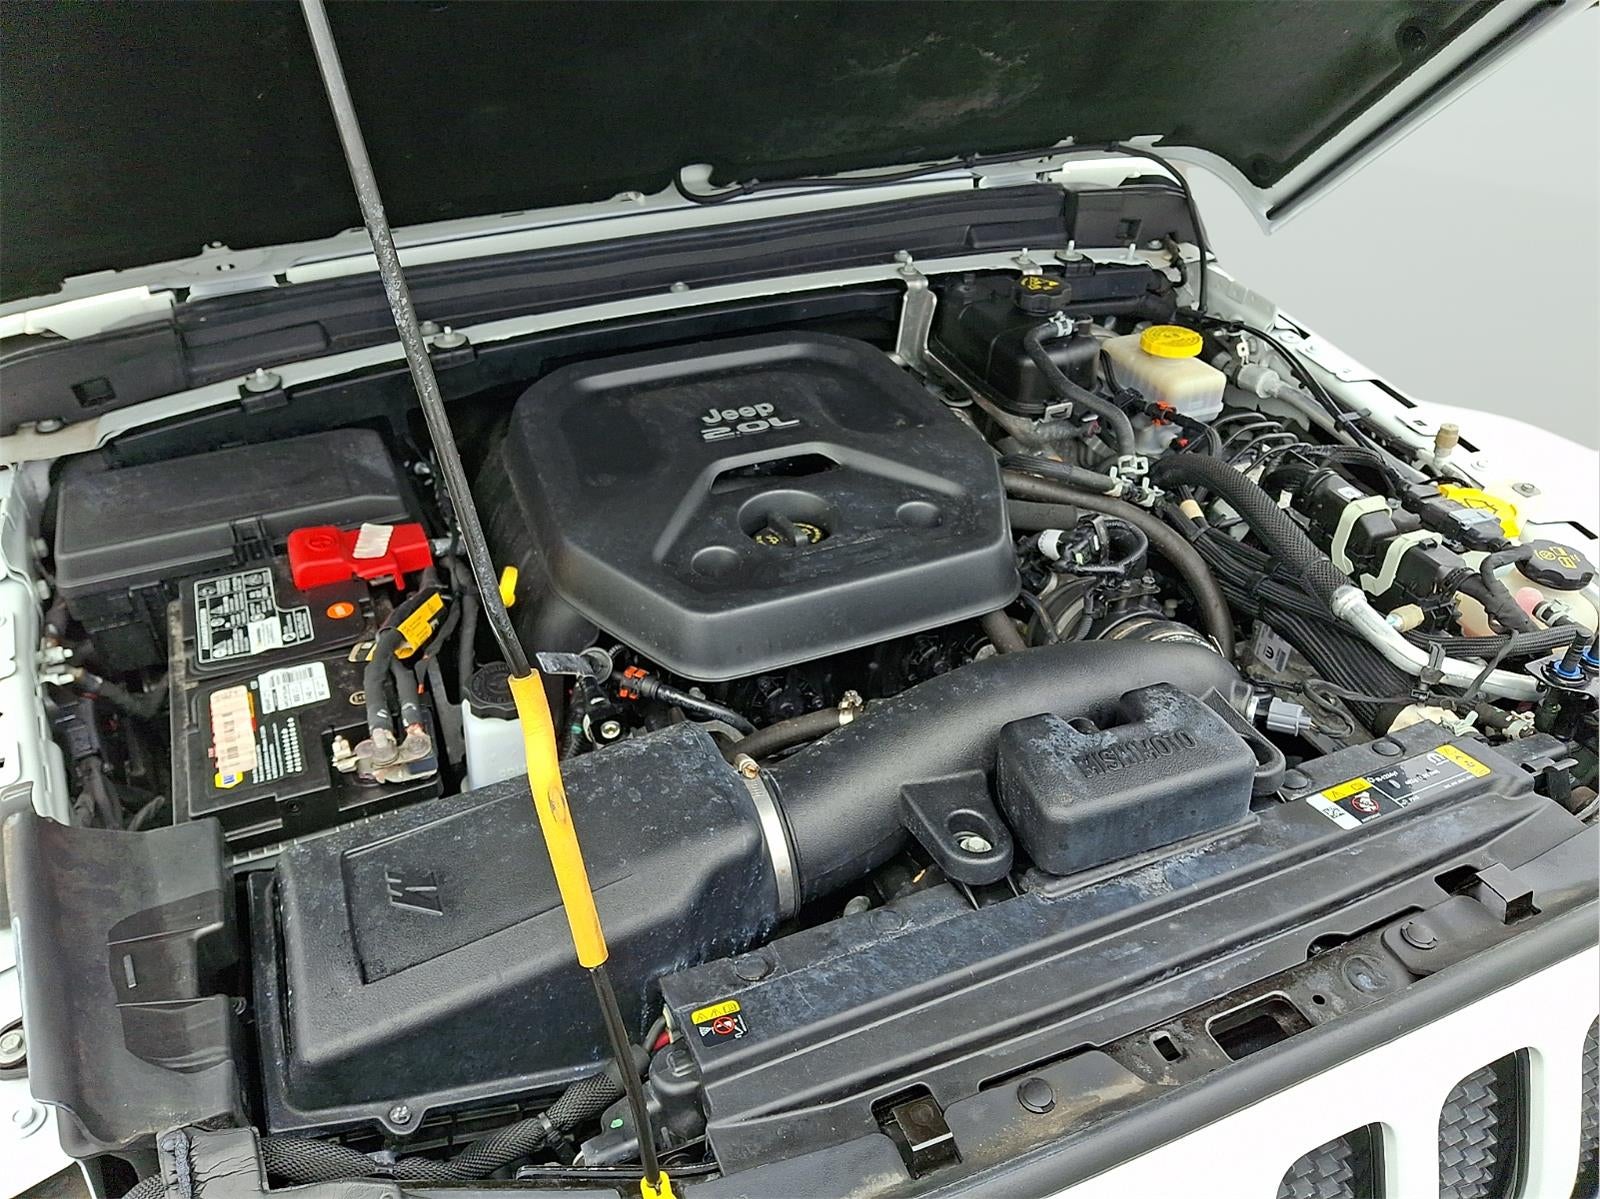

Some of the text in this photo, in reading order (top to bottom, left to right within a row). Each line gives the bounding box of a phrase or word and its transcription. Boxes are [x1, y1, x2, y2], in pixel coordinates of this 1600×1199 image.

[701, 402, 775, 424] Jeep
[700, 416, 800, 442] 2.0L
[1072, 729, 1198, 778] MISHIMOTO
